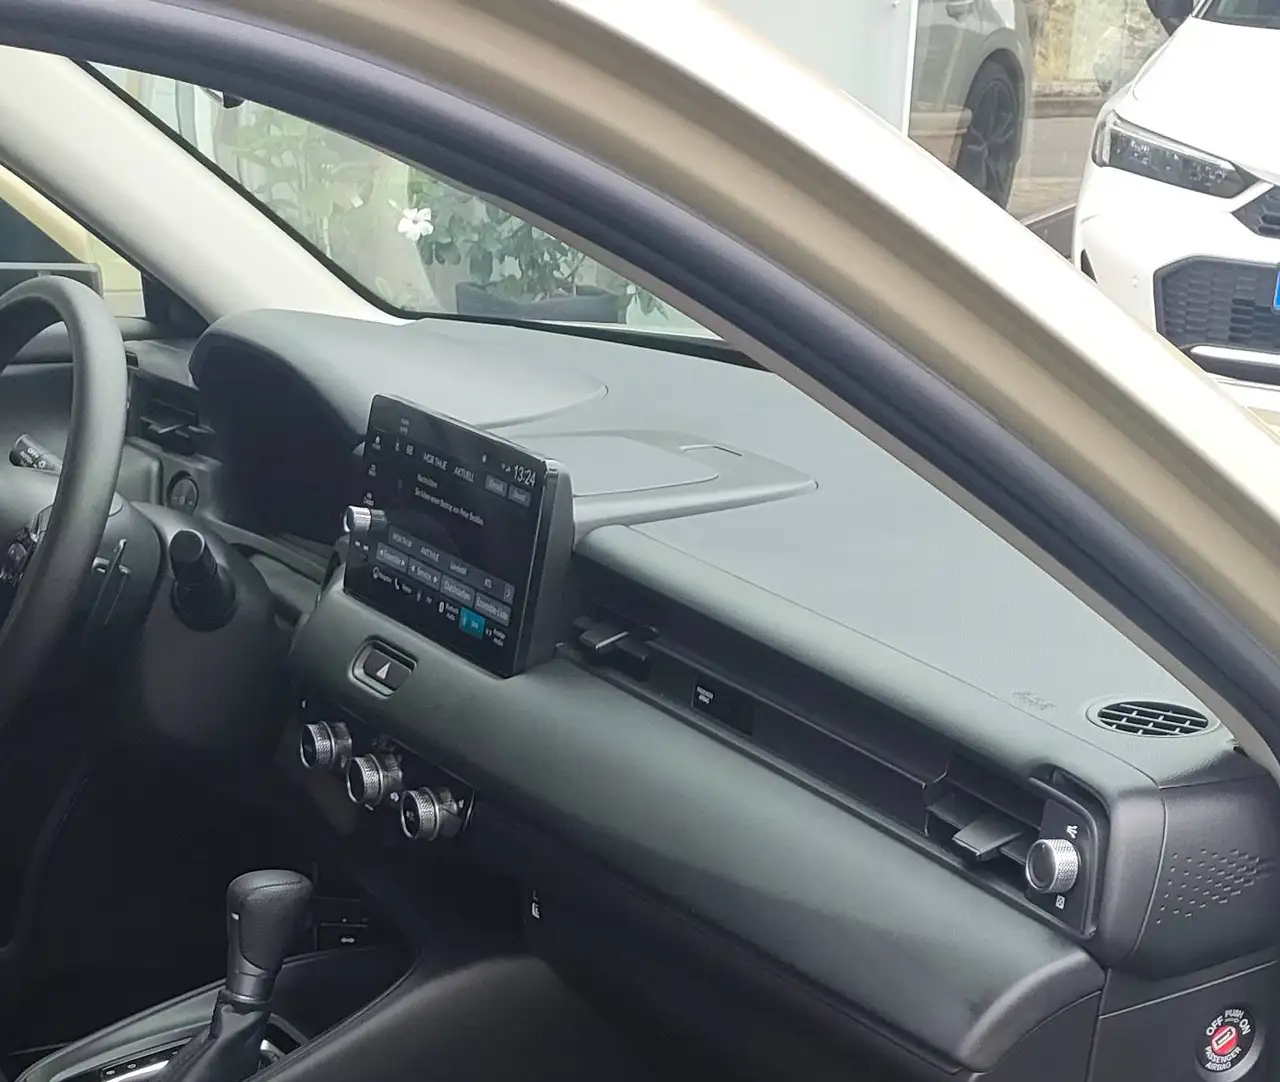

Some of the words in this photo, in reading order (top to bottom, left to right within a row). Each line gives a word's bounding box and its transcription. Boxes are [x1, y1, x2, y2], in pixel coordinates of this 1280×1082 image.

[514, 465, 536, 487] 13:24
[1224, 1009, 1245, 1020] PUSH
[1206, 1015, 1224, 1036] OFF
[1239, 1018, 1252, 1036] ON
[1204, 1045, 1243, 1064] PASSENGER
[1205, 1061, 1232, 1071] AIRBAG
